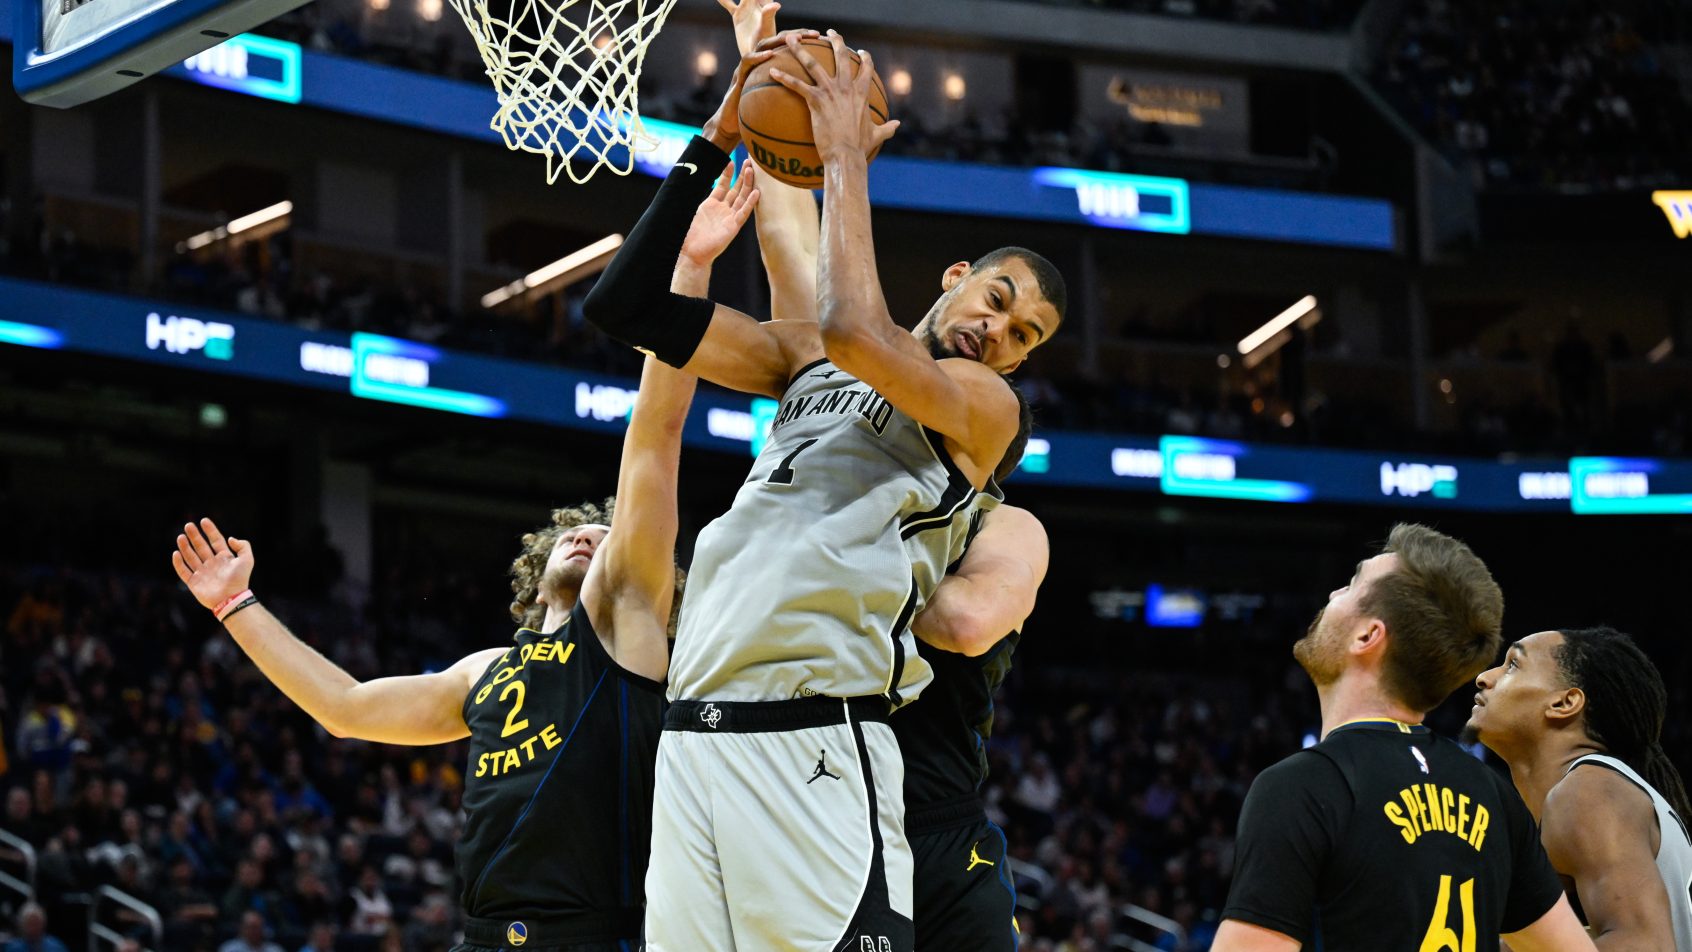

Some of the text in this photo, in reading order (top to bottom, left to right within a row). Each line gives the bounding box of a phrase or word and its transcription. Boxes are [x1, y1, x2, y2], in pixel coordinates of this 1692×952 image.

[766, 438, 819, 485] 1
[498, 680, 530, 739] 2
[475, 723, 563, 778] STATE
[1383, 783, 1490, 852] SPENCER
[1418, 874, 1477, 952] 61
